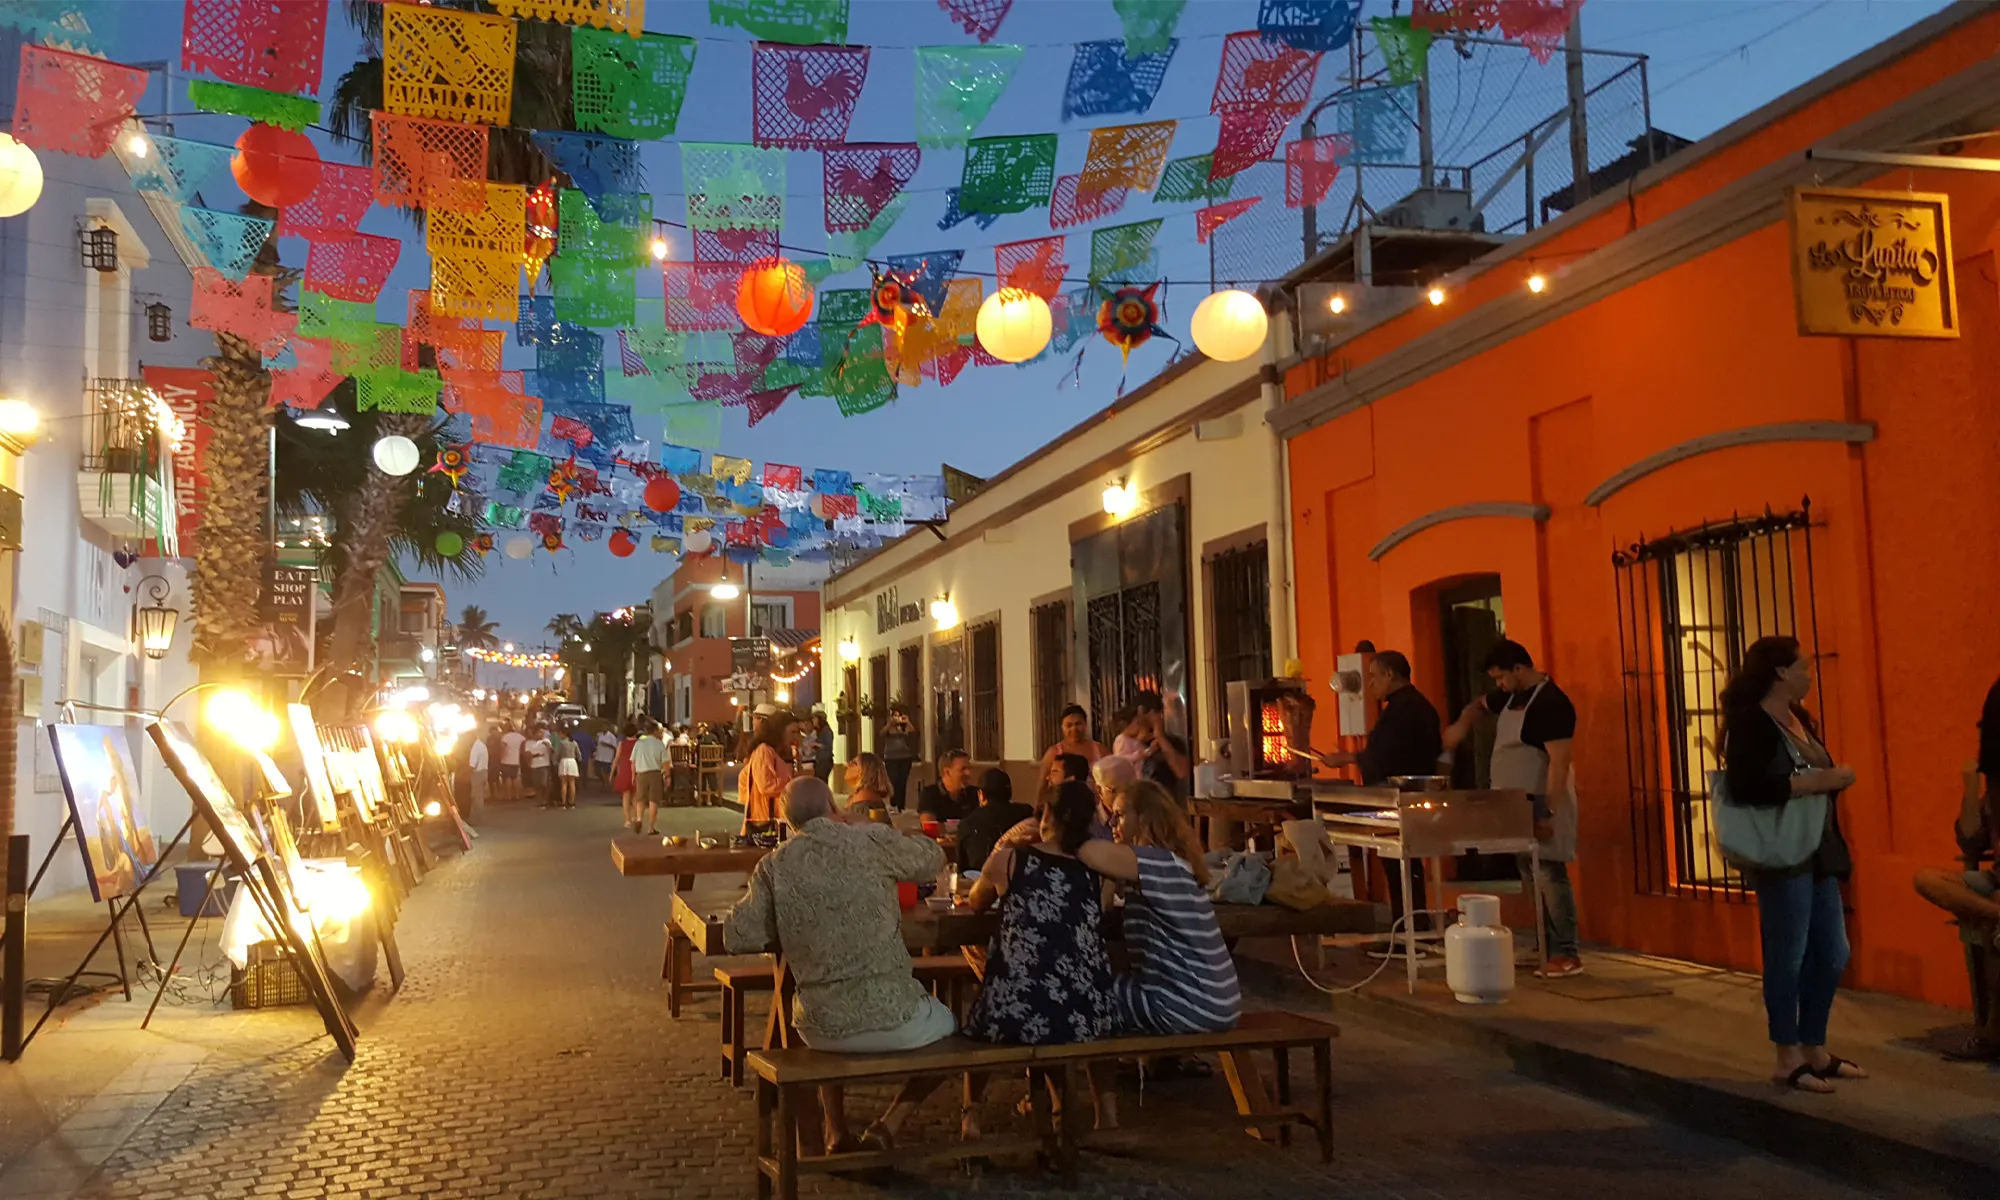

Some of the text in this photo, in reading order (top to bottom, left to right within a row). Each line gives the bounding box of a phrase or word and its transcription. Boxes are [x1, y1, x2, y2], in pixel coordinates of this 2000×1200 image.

[274, 570, 307, 581] EAT
[273, 583, 307, 593] SHOP
[273, 595, 305, 605] PLAY
